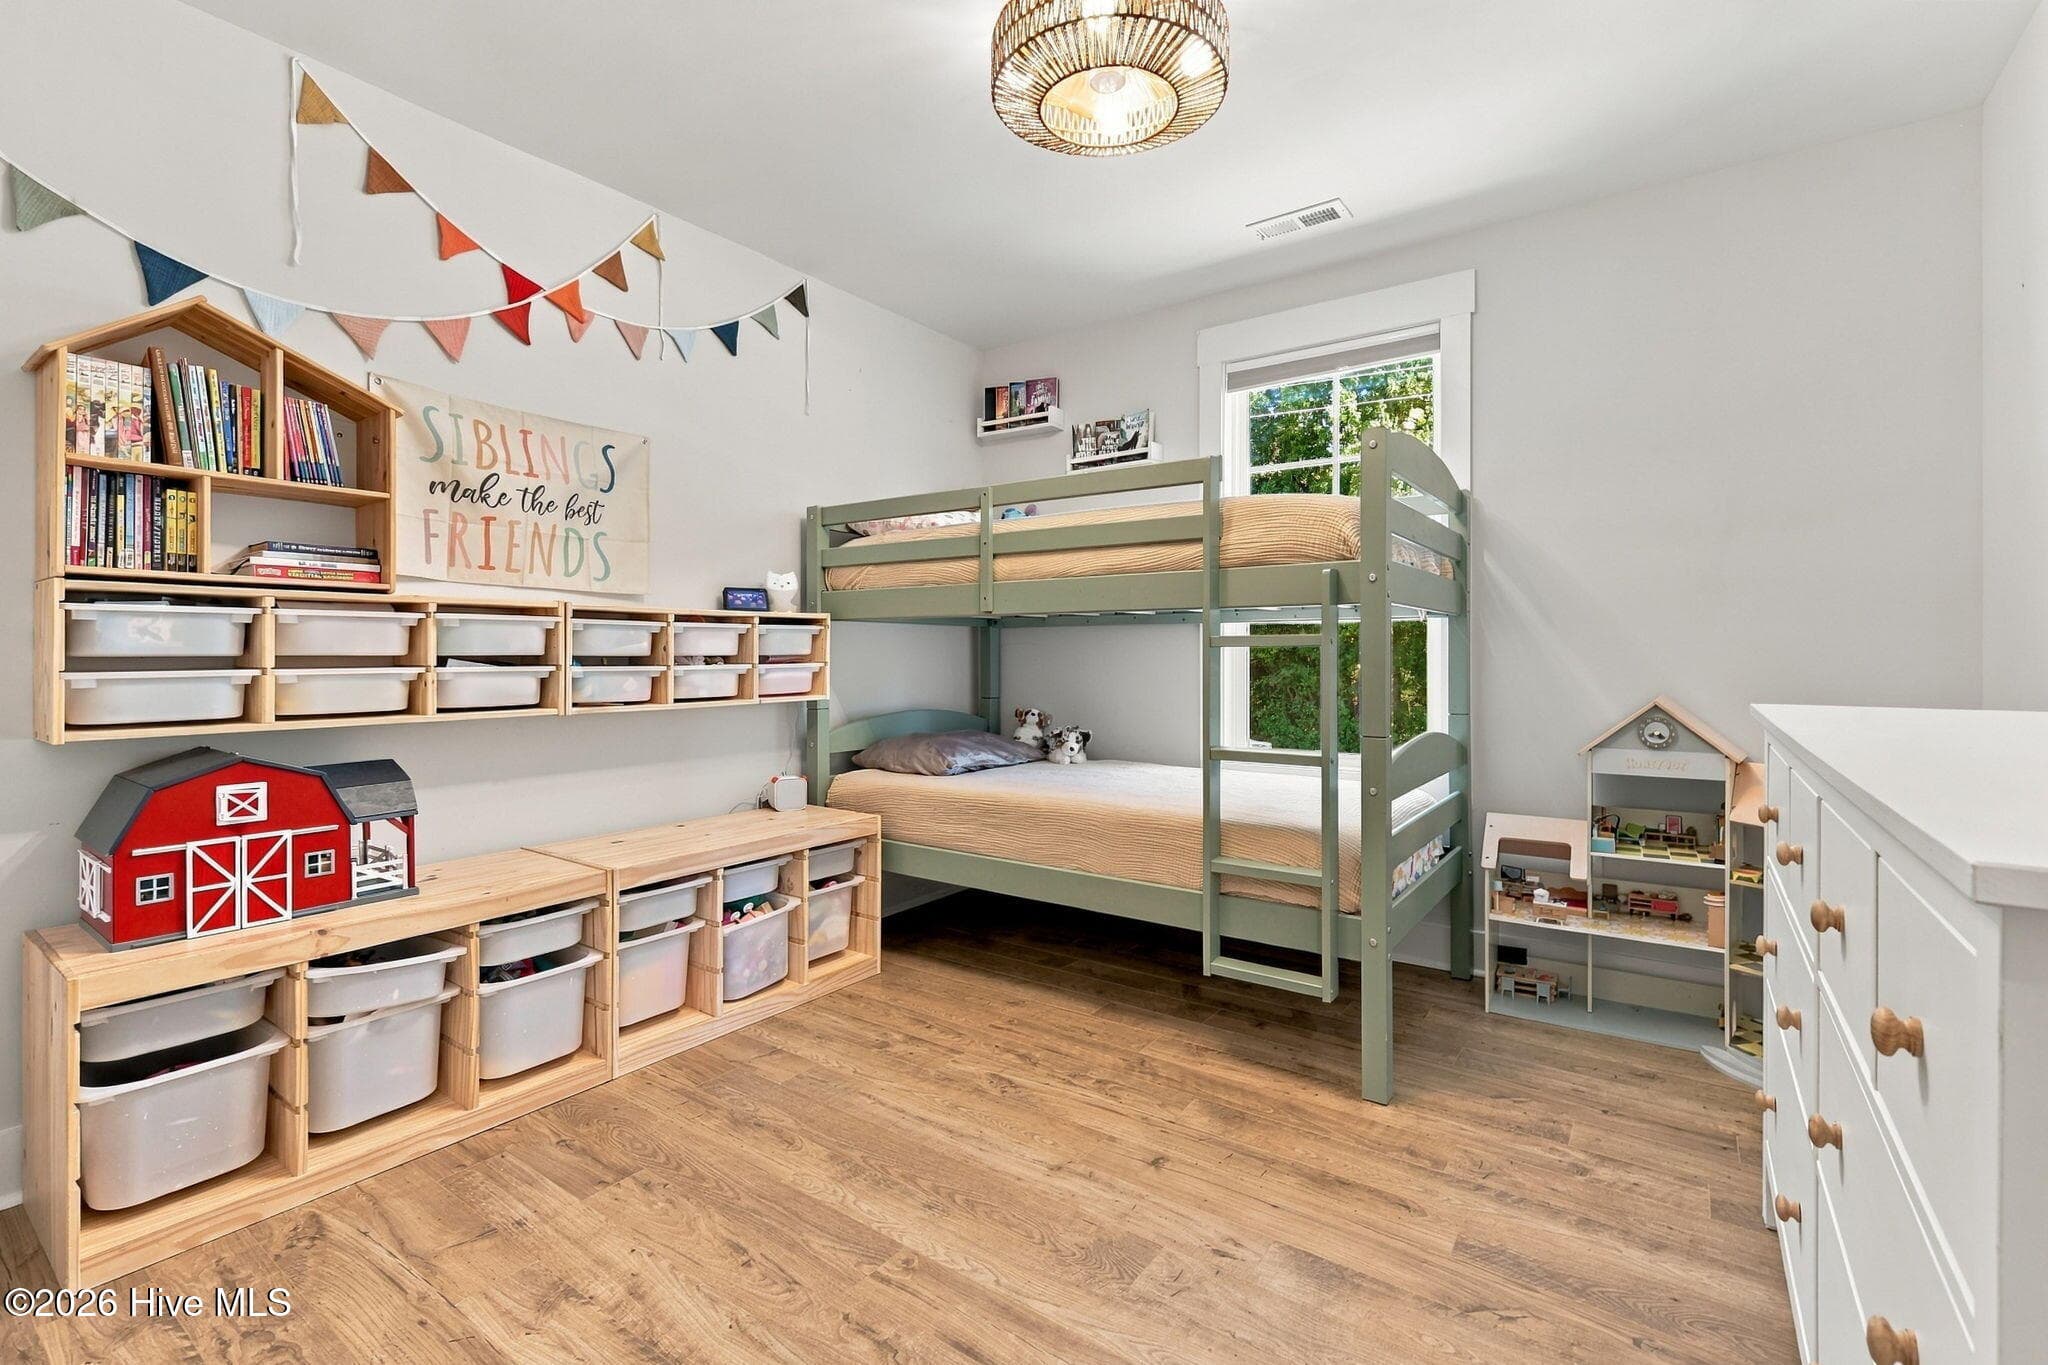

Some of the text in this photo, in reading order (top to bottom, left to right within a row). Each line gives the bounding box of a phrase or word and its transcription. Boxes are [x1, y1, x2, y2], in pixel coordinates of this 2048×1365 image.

[419, 405, 616, 494] SIBLINGS
[429, 472, 605, 526] make the best
[422, 508, 611, 582] FRIENDS
